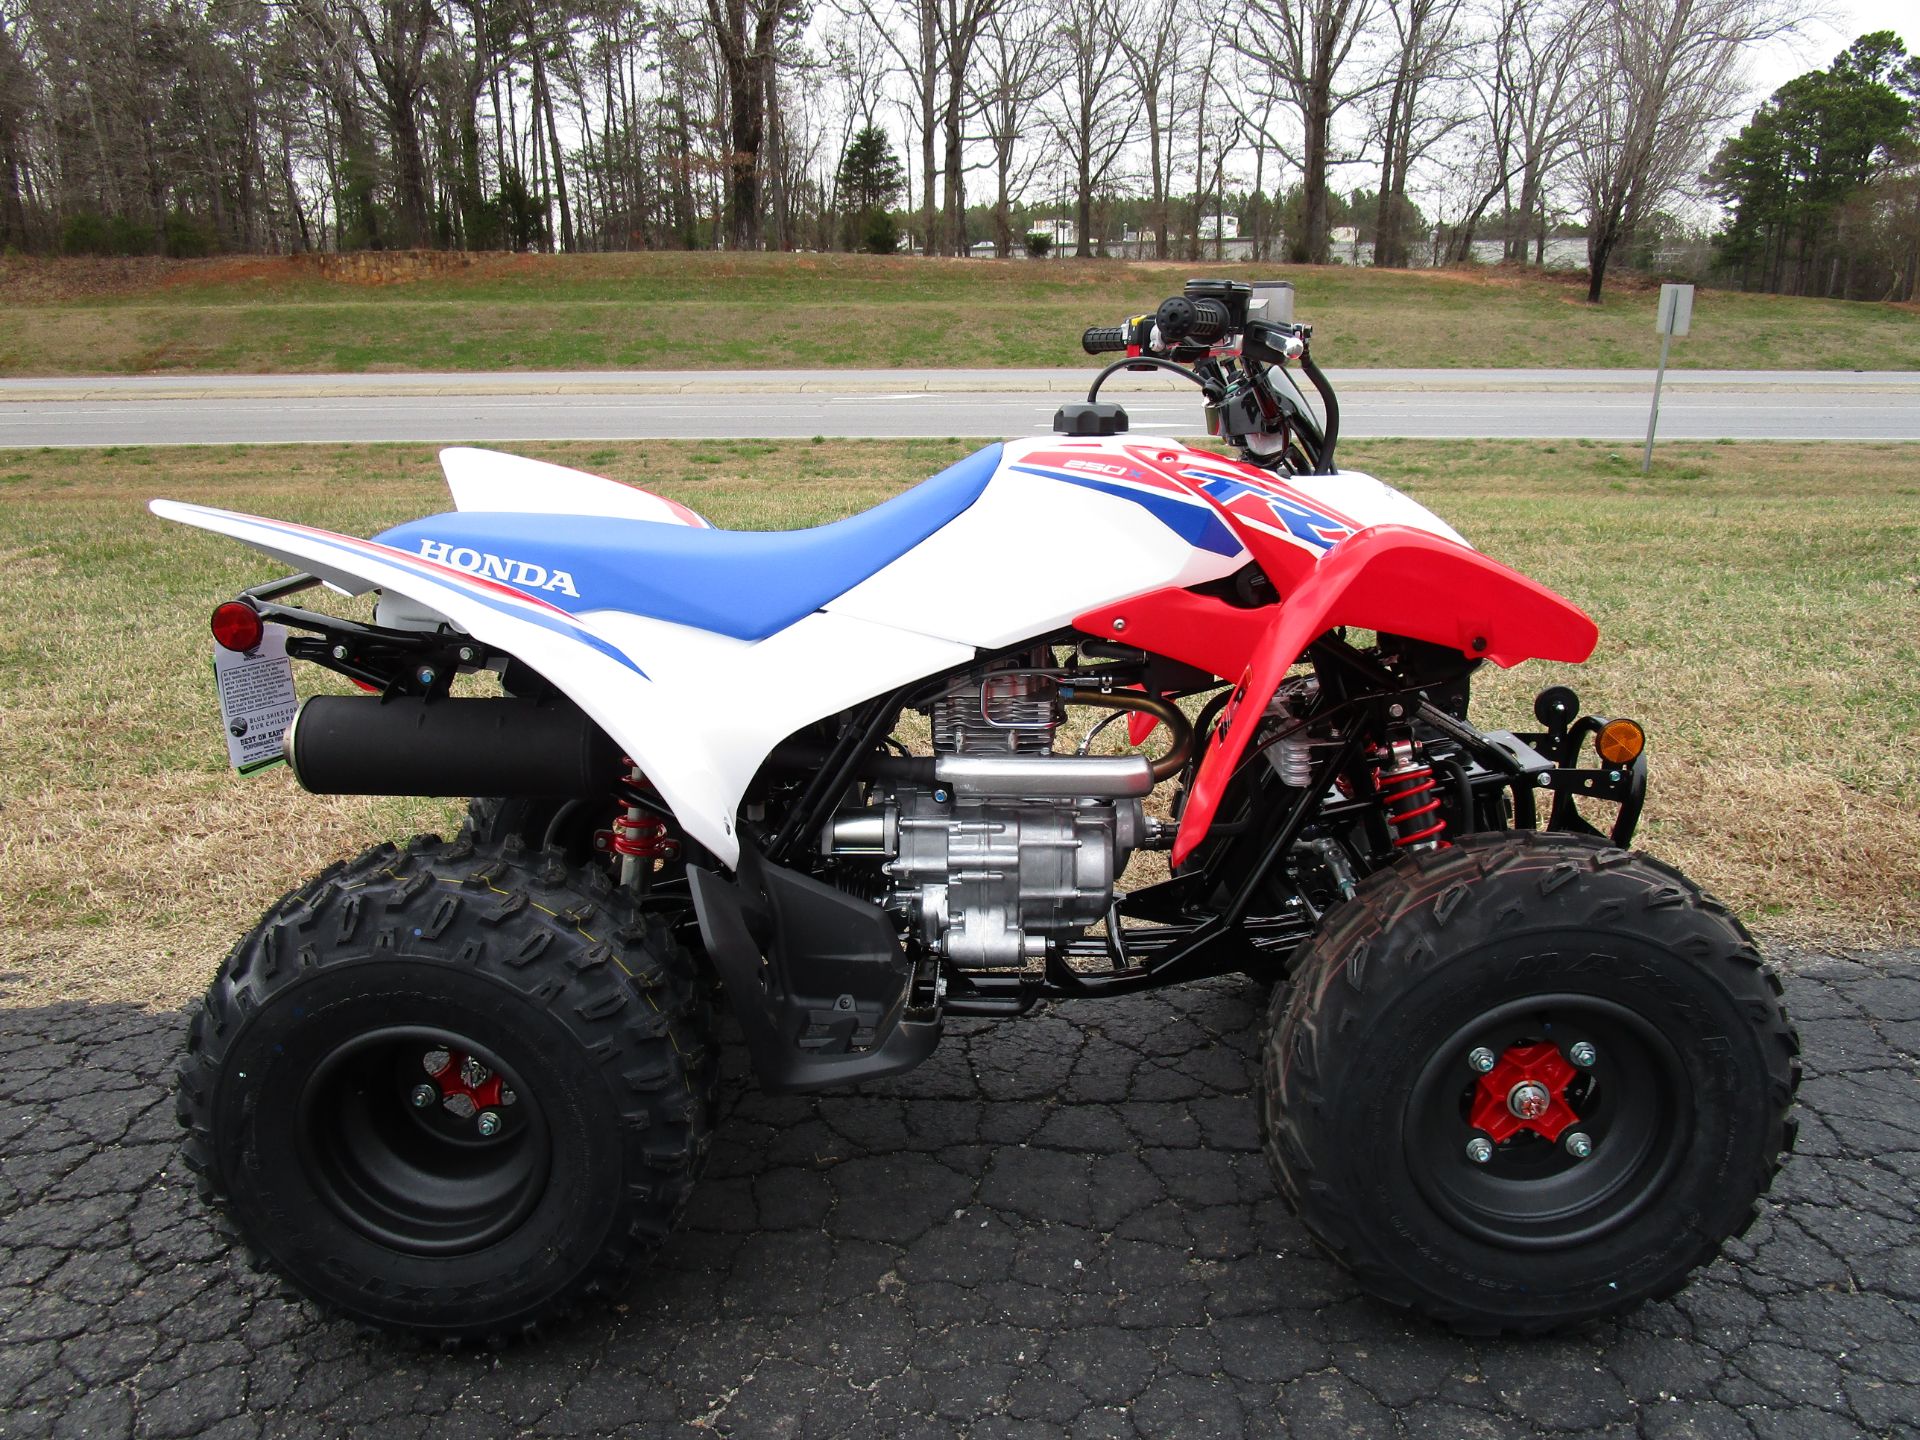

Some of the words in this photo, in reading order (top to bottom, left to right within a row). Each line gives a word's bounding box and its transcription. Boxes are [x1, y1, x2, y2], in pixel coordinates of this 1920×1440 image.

[1178, 469, 1354, 555] TR
[418, 538, 581, 599] HONDA
[250, 723, 264, 731] OUR
[266, 716, 294, 727] CHILDR
[267, 711, 285, 720] SKIES
[240, 736, 256, 746] BEST
[258, 733, 267, 741] ON
[268, 728, 286, 738] EART
